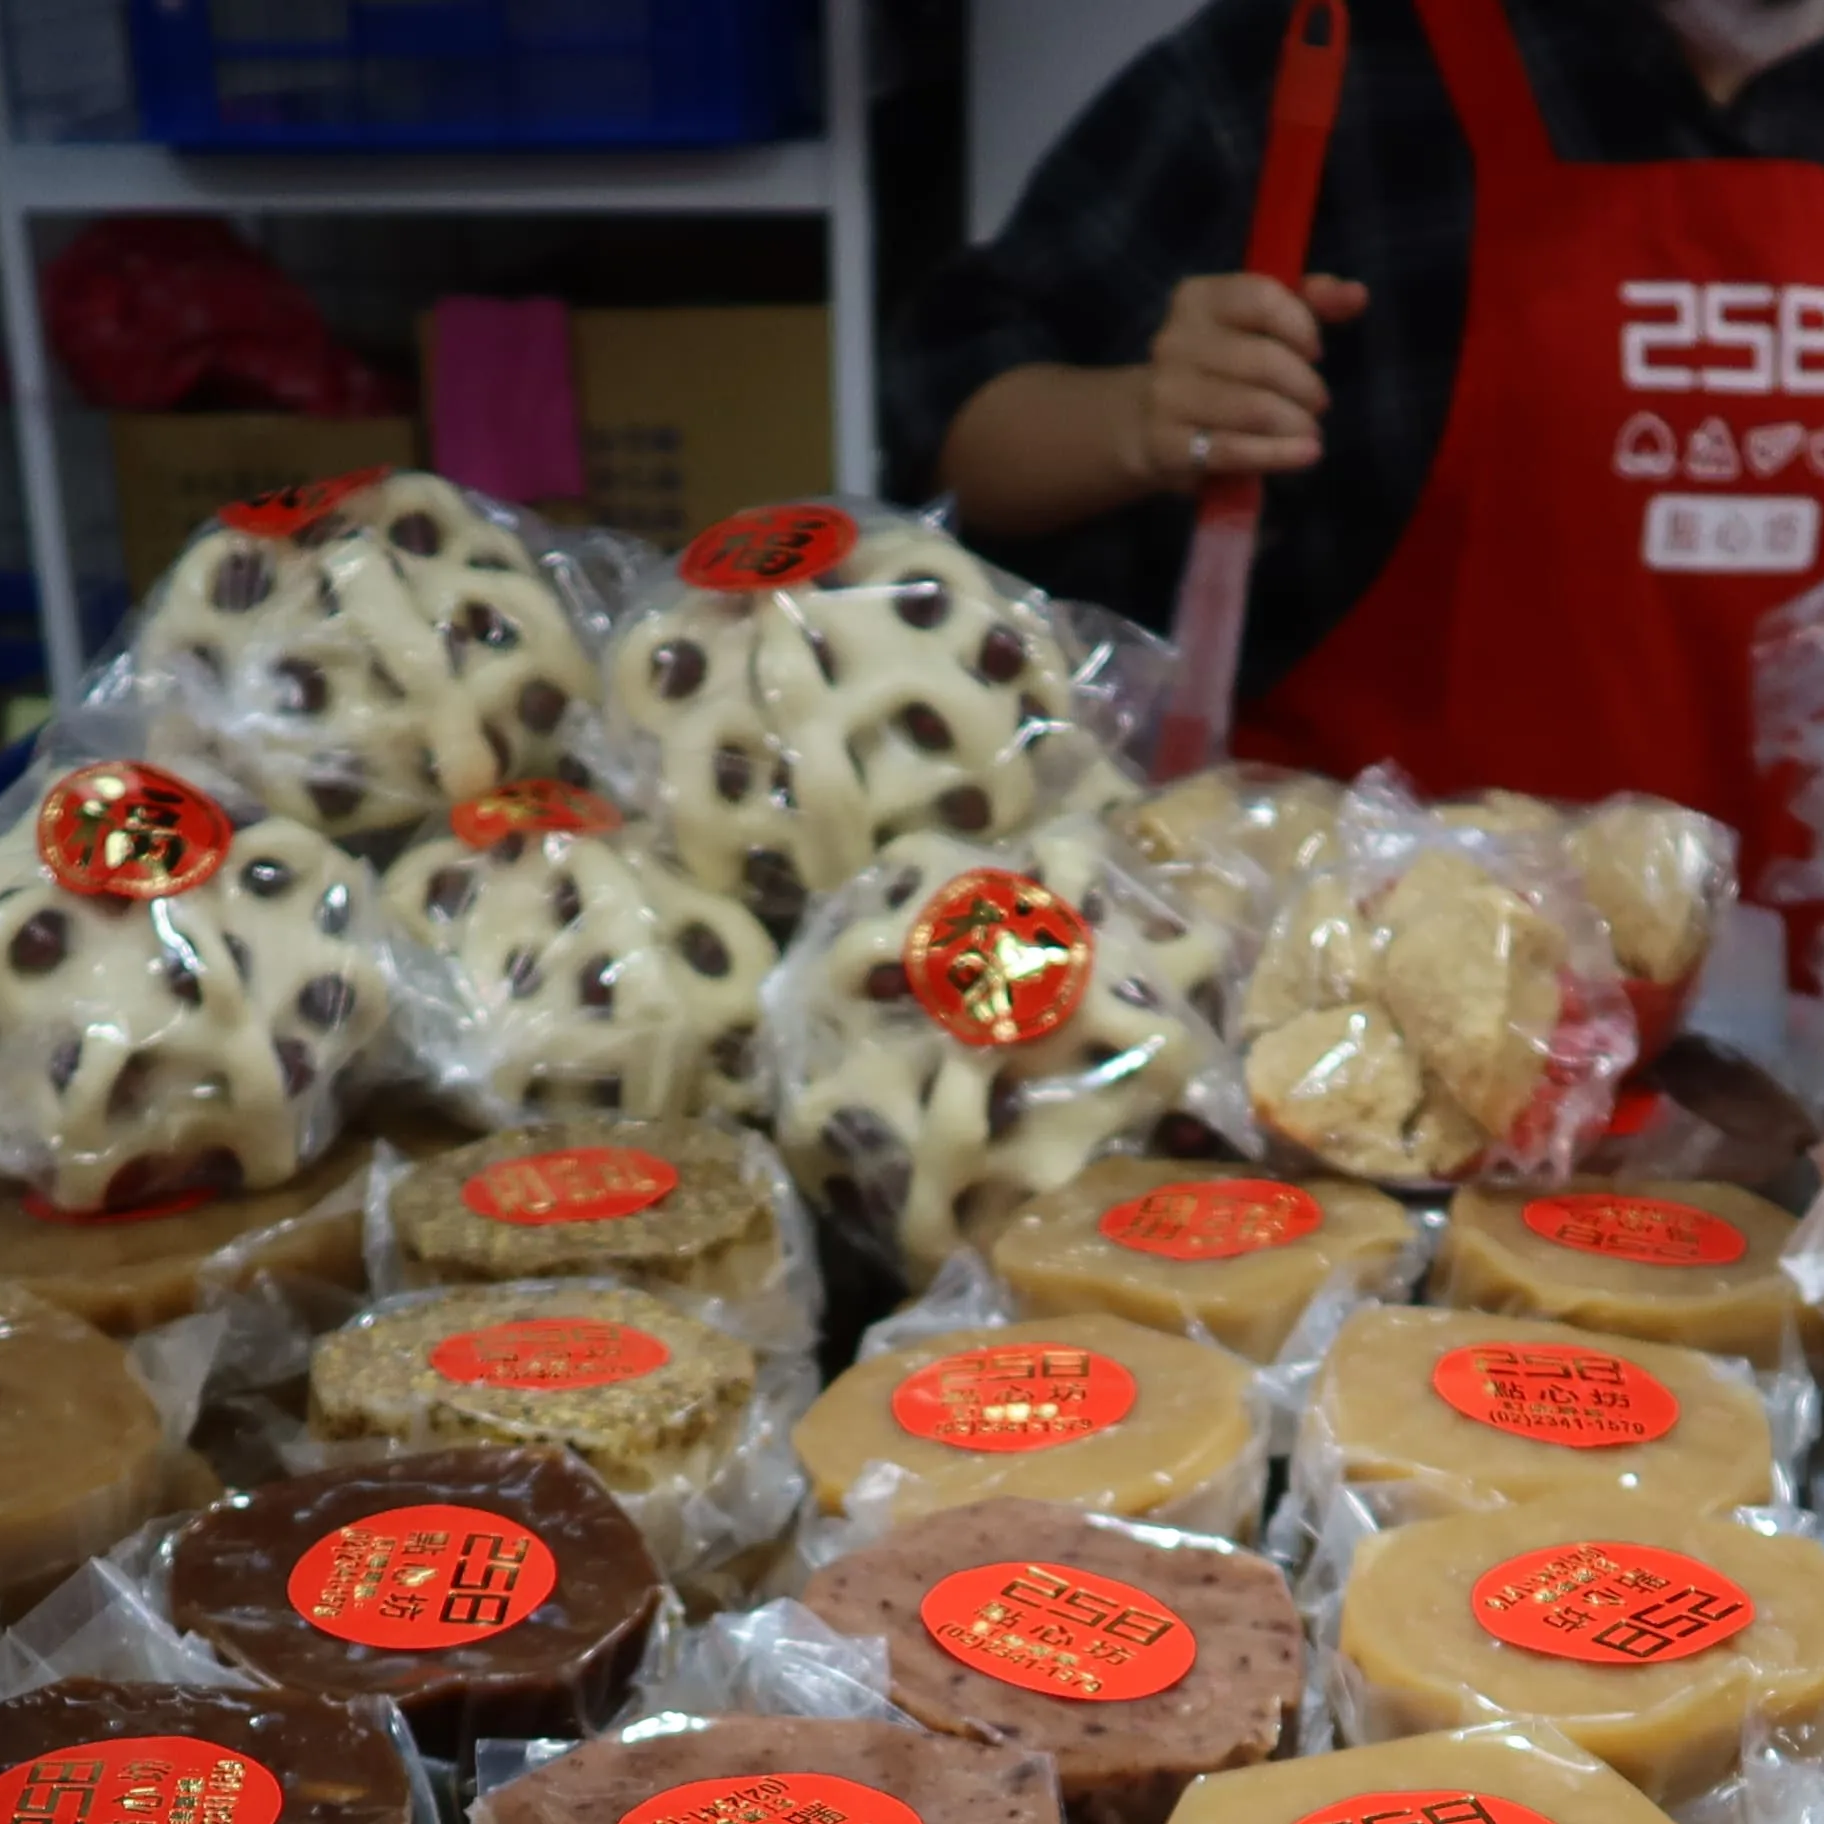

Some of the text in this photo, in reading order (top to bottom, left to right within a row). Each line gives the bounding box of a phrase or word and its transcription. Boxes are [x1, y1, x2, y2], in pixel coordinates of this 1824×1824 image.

[439, 1532, 531, 1626] 258
[1001, 1565, 1174, 1646] 258
[1592, 1585, 1744, 1657] 258
